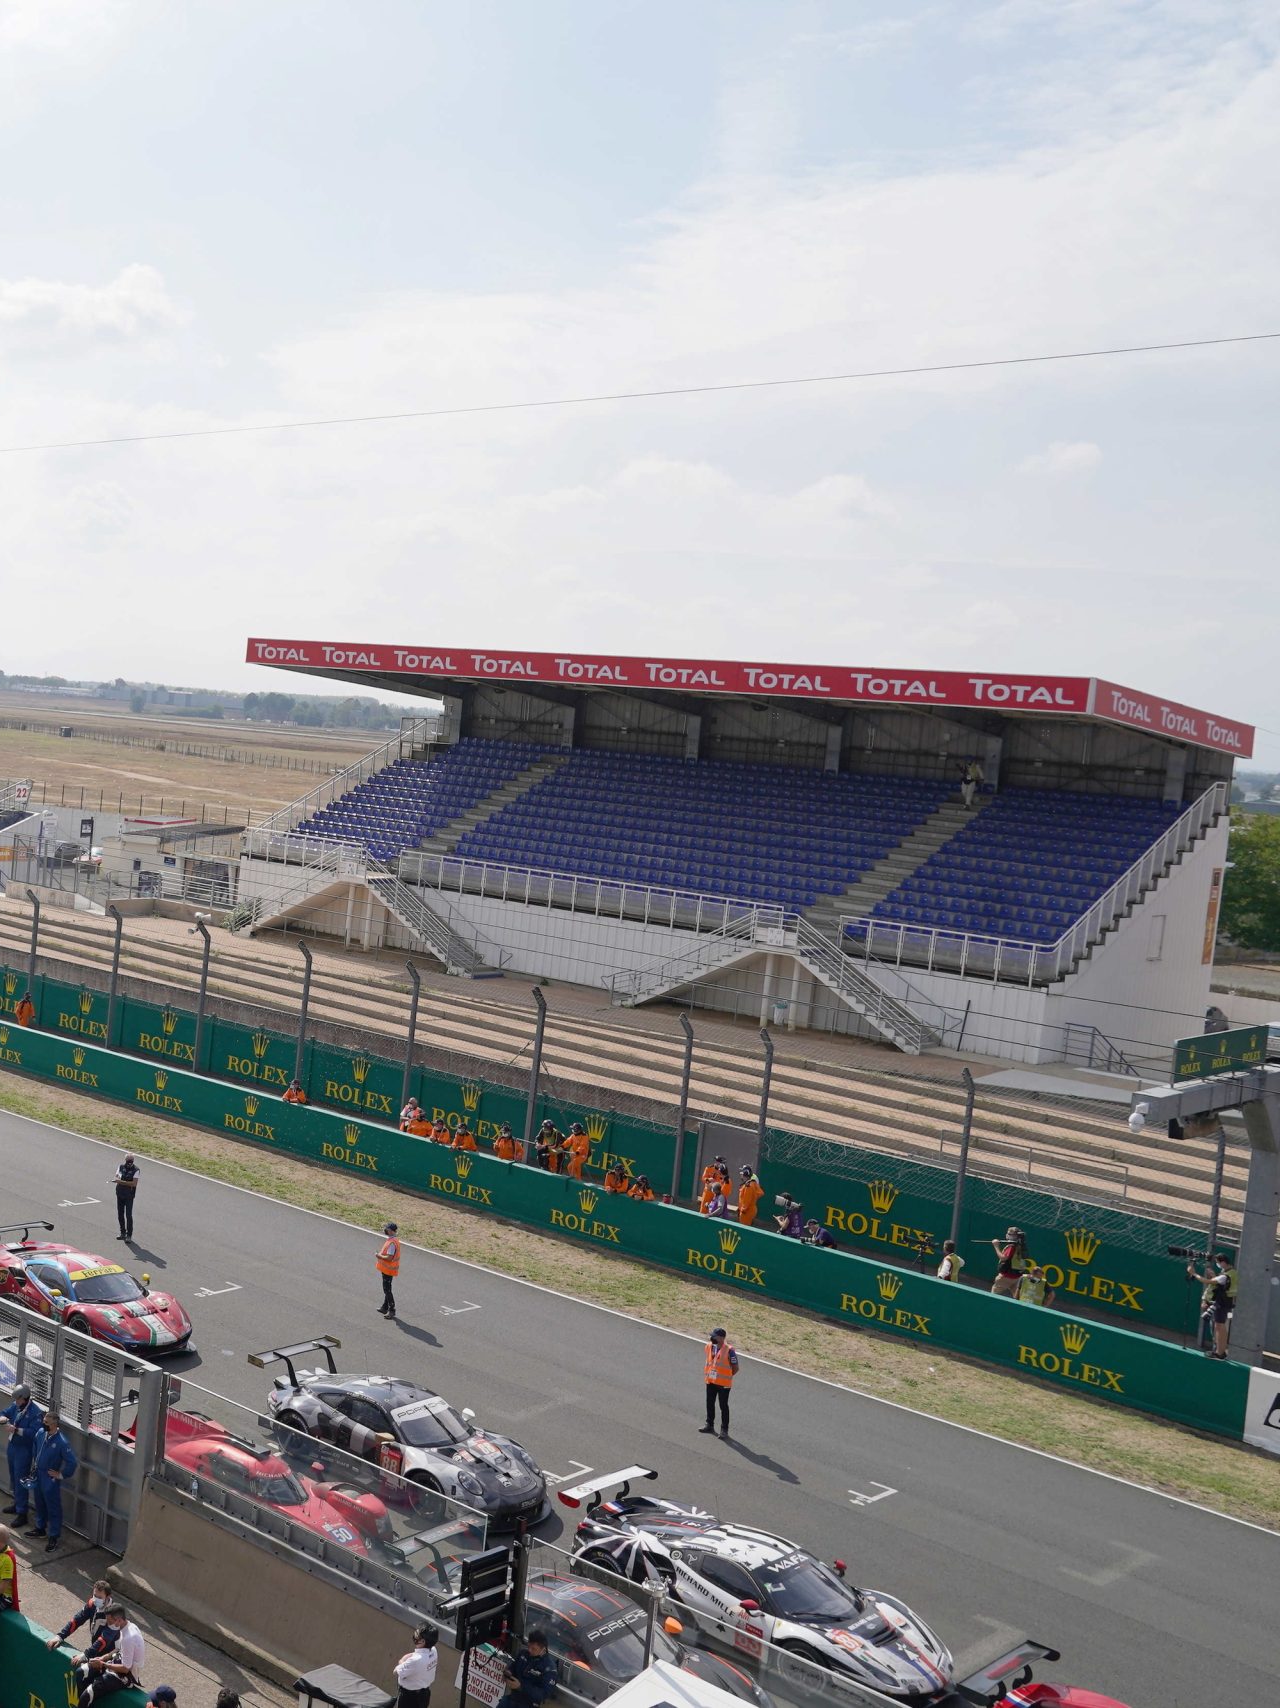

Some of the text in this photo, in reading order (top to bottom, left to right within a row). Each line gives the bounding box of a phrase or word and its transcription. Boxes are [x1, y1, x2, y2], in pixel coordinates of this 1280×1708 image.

[255, 643, 1074, 705] TOTAL TOTAL TOTAL TOTAL TOTAL TOTAL TOTAL TOTAL TOTAL
[1111, 691, 1241, 748] TOTAL TOTAL TOTAL
[1181, 1051, 1261, 1074] ROLEX ROLEX ROLEX
[59, 1013, 108, 1039] ROLEX
[139, 1033, 195, 1061] ROLEX
[227, 1055, 288, 1086] ROLEX
[325, 1080, 392, 1114] ROLEX
[584, 1151, 636, 1178] LEX
[824, 1206, 934, 1255] ROLEX
[56, 1064, 99, 1088] ROLEX
[137, 1087, 183, 1113] ROLEX
[224, 1113, 275, 1141] ROLEX
[322, 1143, 378, 1171] ROLEX
[430, 1174, 492, 1206] ROLEX
[551, 1209, 621, 1244] ROLEX
[687, 1248, 766, 1287] ROLEX
[840, 1293, 932, 1336] ROLEX
[1018, 1345, 1124, 1394] ROLEX
[81, 1267, 116, 1277] Ferrari
[181, 1416, 204, 1430] MILLE
[382, 1455, 397, 1469] 88
[332, 1527, 353, 1542] 50
[767, 1554, 808, 1573] WAFA
[676, 1566, 735, 1618] RICHARD MILLE
[587, 1608, 648, 1642] PORSCHE
[467, 1684, 493, 1703] ORWARD
[471, 1676, 499, 1697] NOT LEAN
